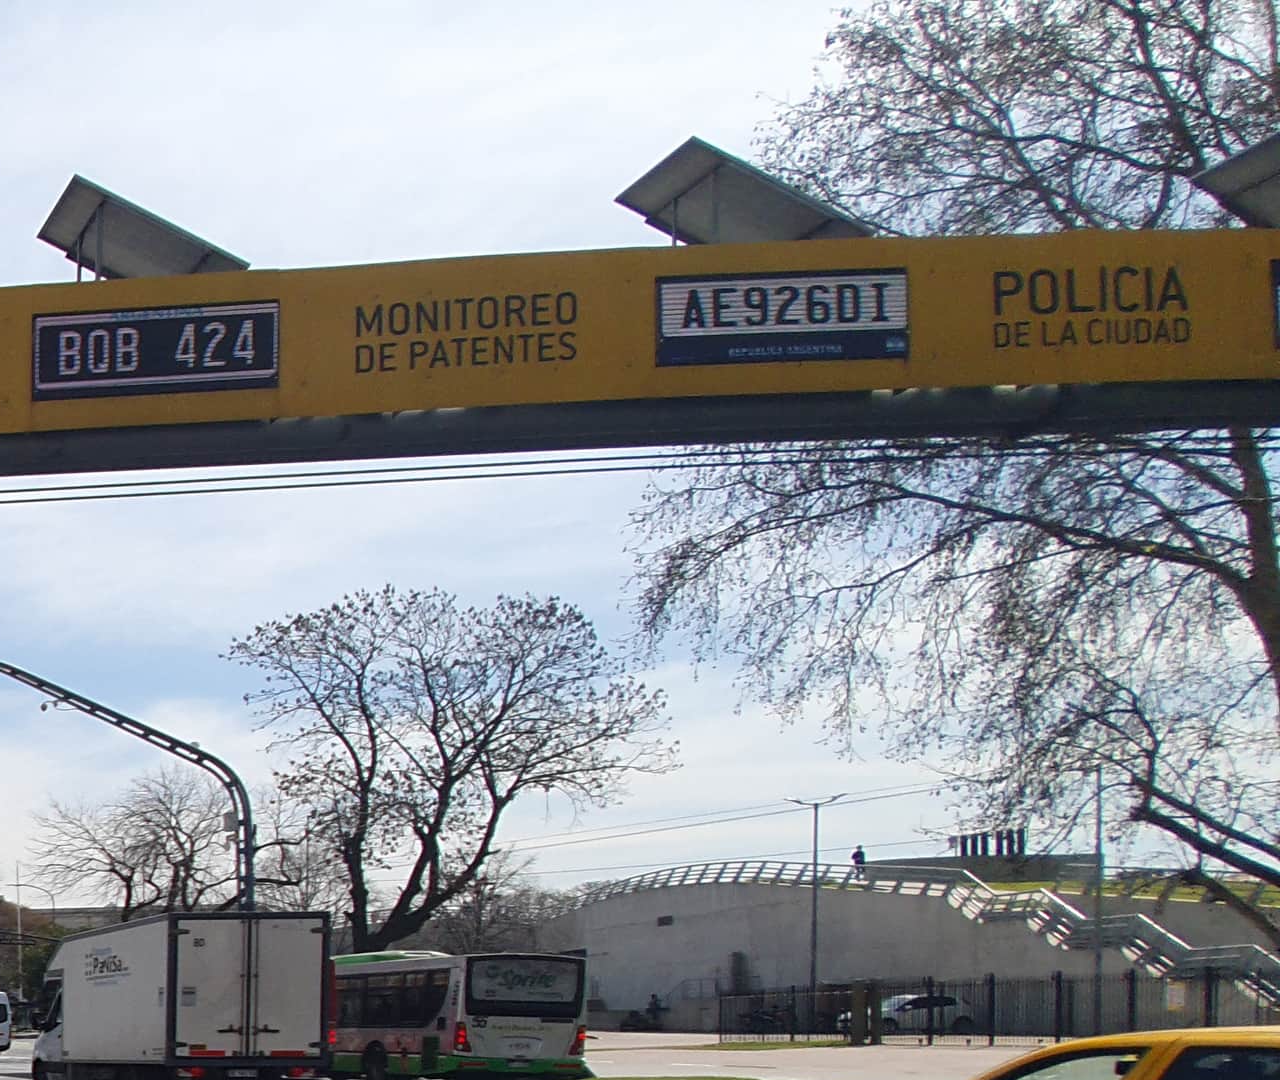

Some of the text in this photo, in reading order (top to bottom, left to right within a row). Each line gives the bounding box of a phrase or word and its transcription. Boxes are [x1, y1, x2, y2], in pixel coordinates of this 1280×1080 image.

[682, 282, 890, 329] AE926DI
[993, 265, 1189, 316] POLICIA
[355, 291, 578, 338] MONITOREO
[993, 317, 1191, 349] DE LA CIUDAD
[175, 319, 256, 368] 424
[355, 332, 577, 374] DE PATENTES
